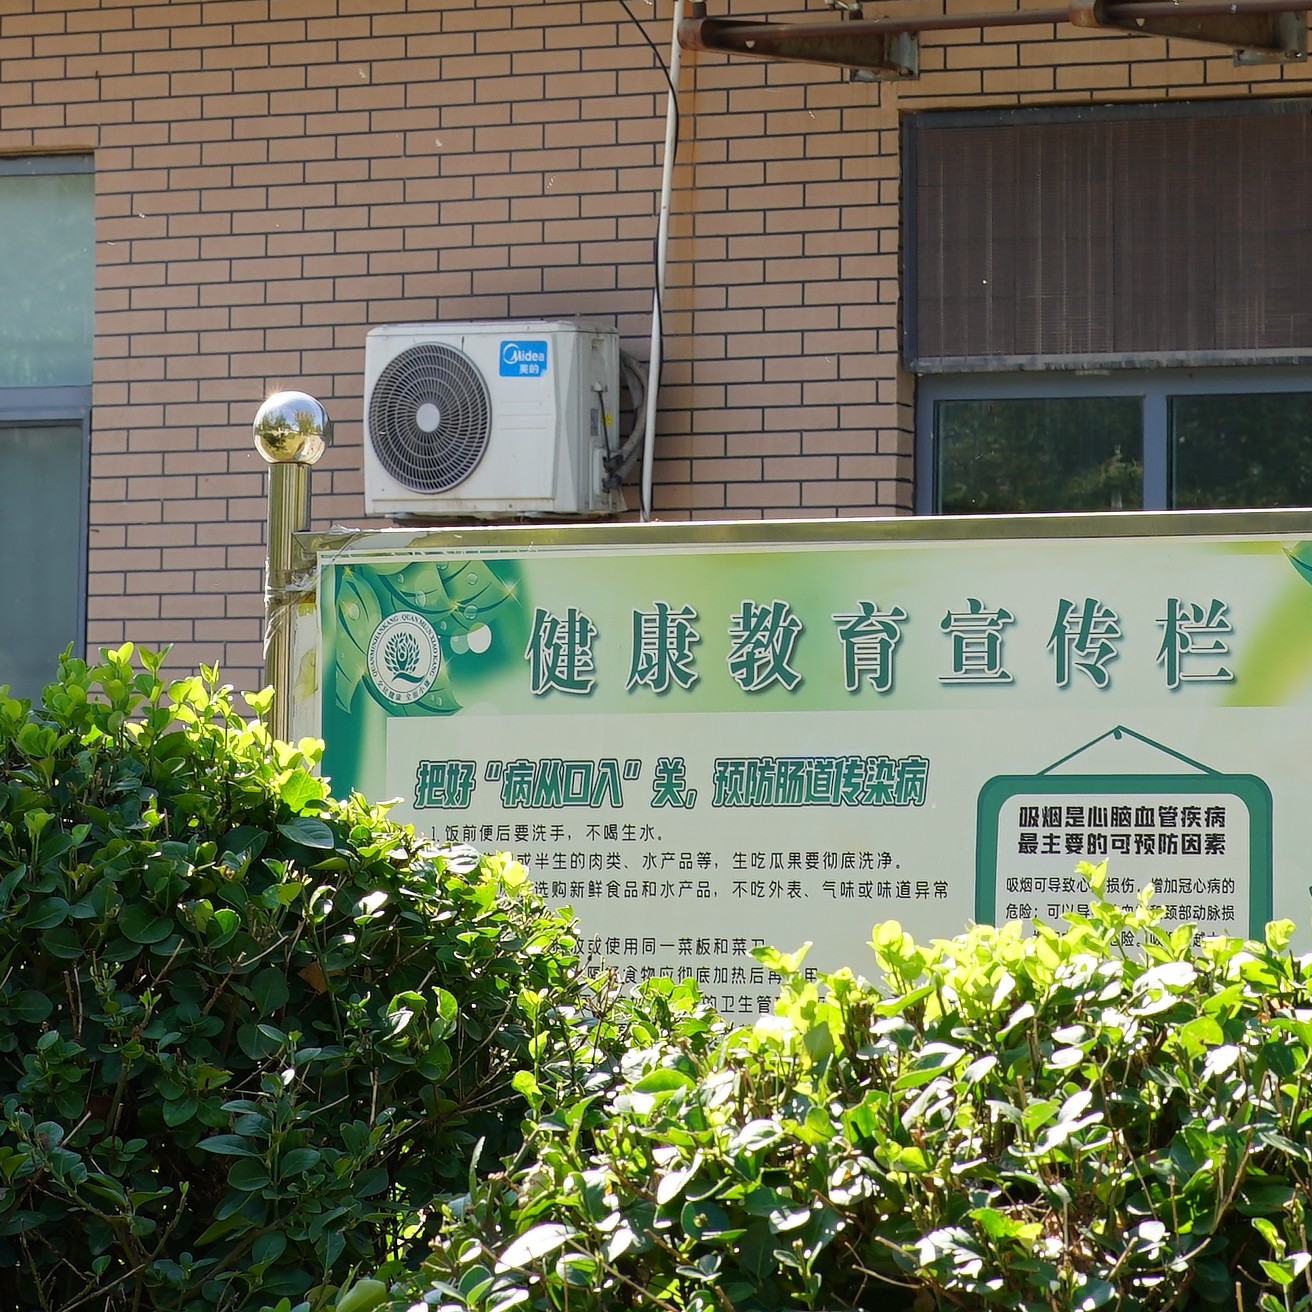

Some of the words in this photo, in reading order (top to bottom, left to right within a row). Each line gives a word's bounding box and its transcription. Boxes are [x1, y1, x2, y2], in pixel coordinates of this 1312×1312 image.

[504, 344, 545, 364] Midea
[519, 364, 540, 375] 美的
[525, 597, 1237, 696] 健康教育宣传栏
[1018, 806, 1226, 828] 吸烟是心脑血管疾病
[1018, 832, 1226, 855] 最主要的可预防因素
[1006, 876, 1236, 894] 吸烟可导致心损伤，增加冠心病的
